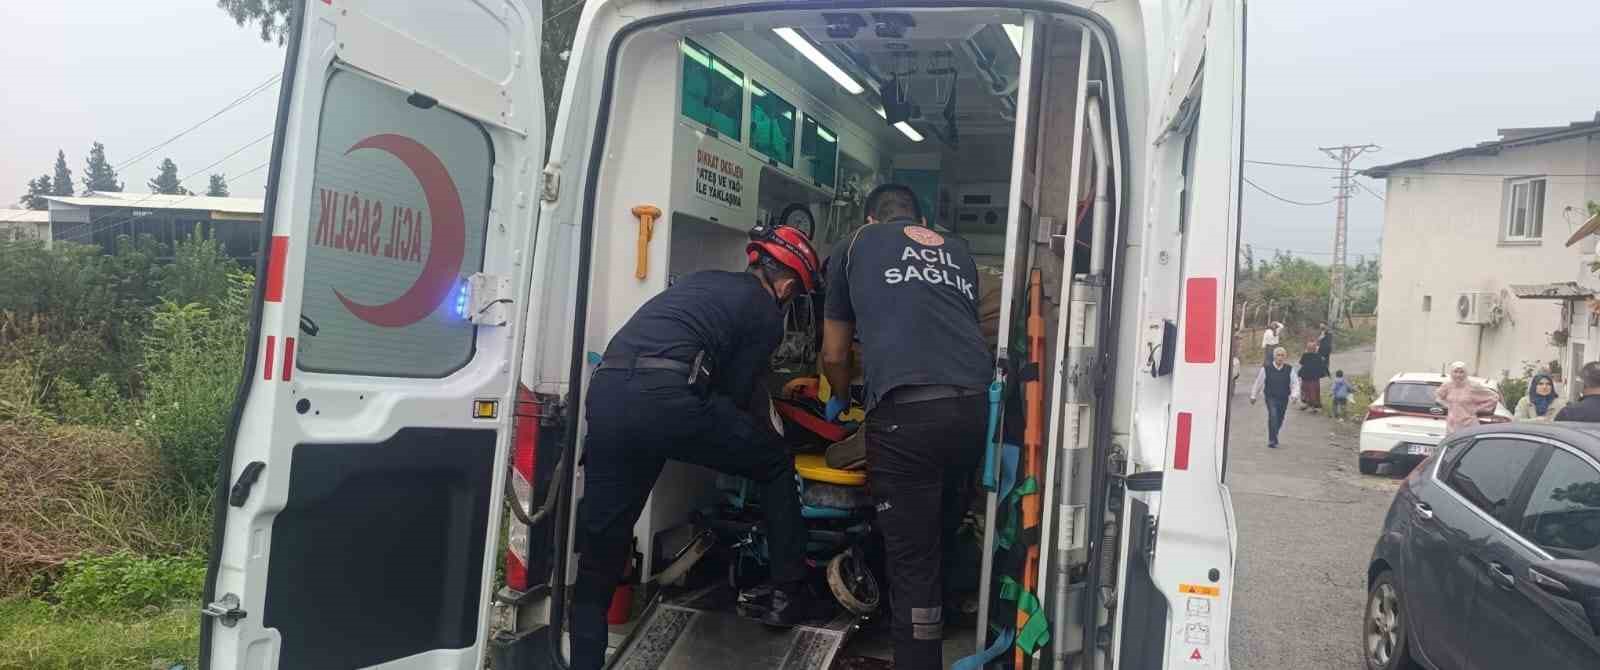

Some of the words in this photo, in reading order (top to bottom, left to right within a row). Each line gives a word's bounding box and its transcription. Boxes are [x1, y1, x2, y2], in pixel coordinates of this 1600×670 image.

[718, 175, 727, 187] VE
[901, 246, 961, 270] ACİL
[884, 263, 974, 300] SAĞLIK
